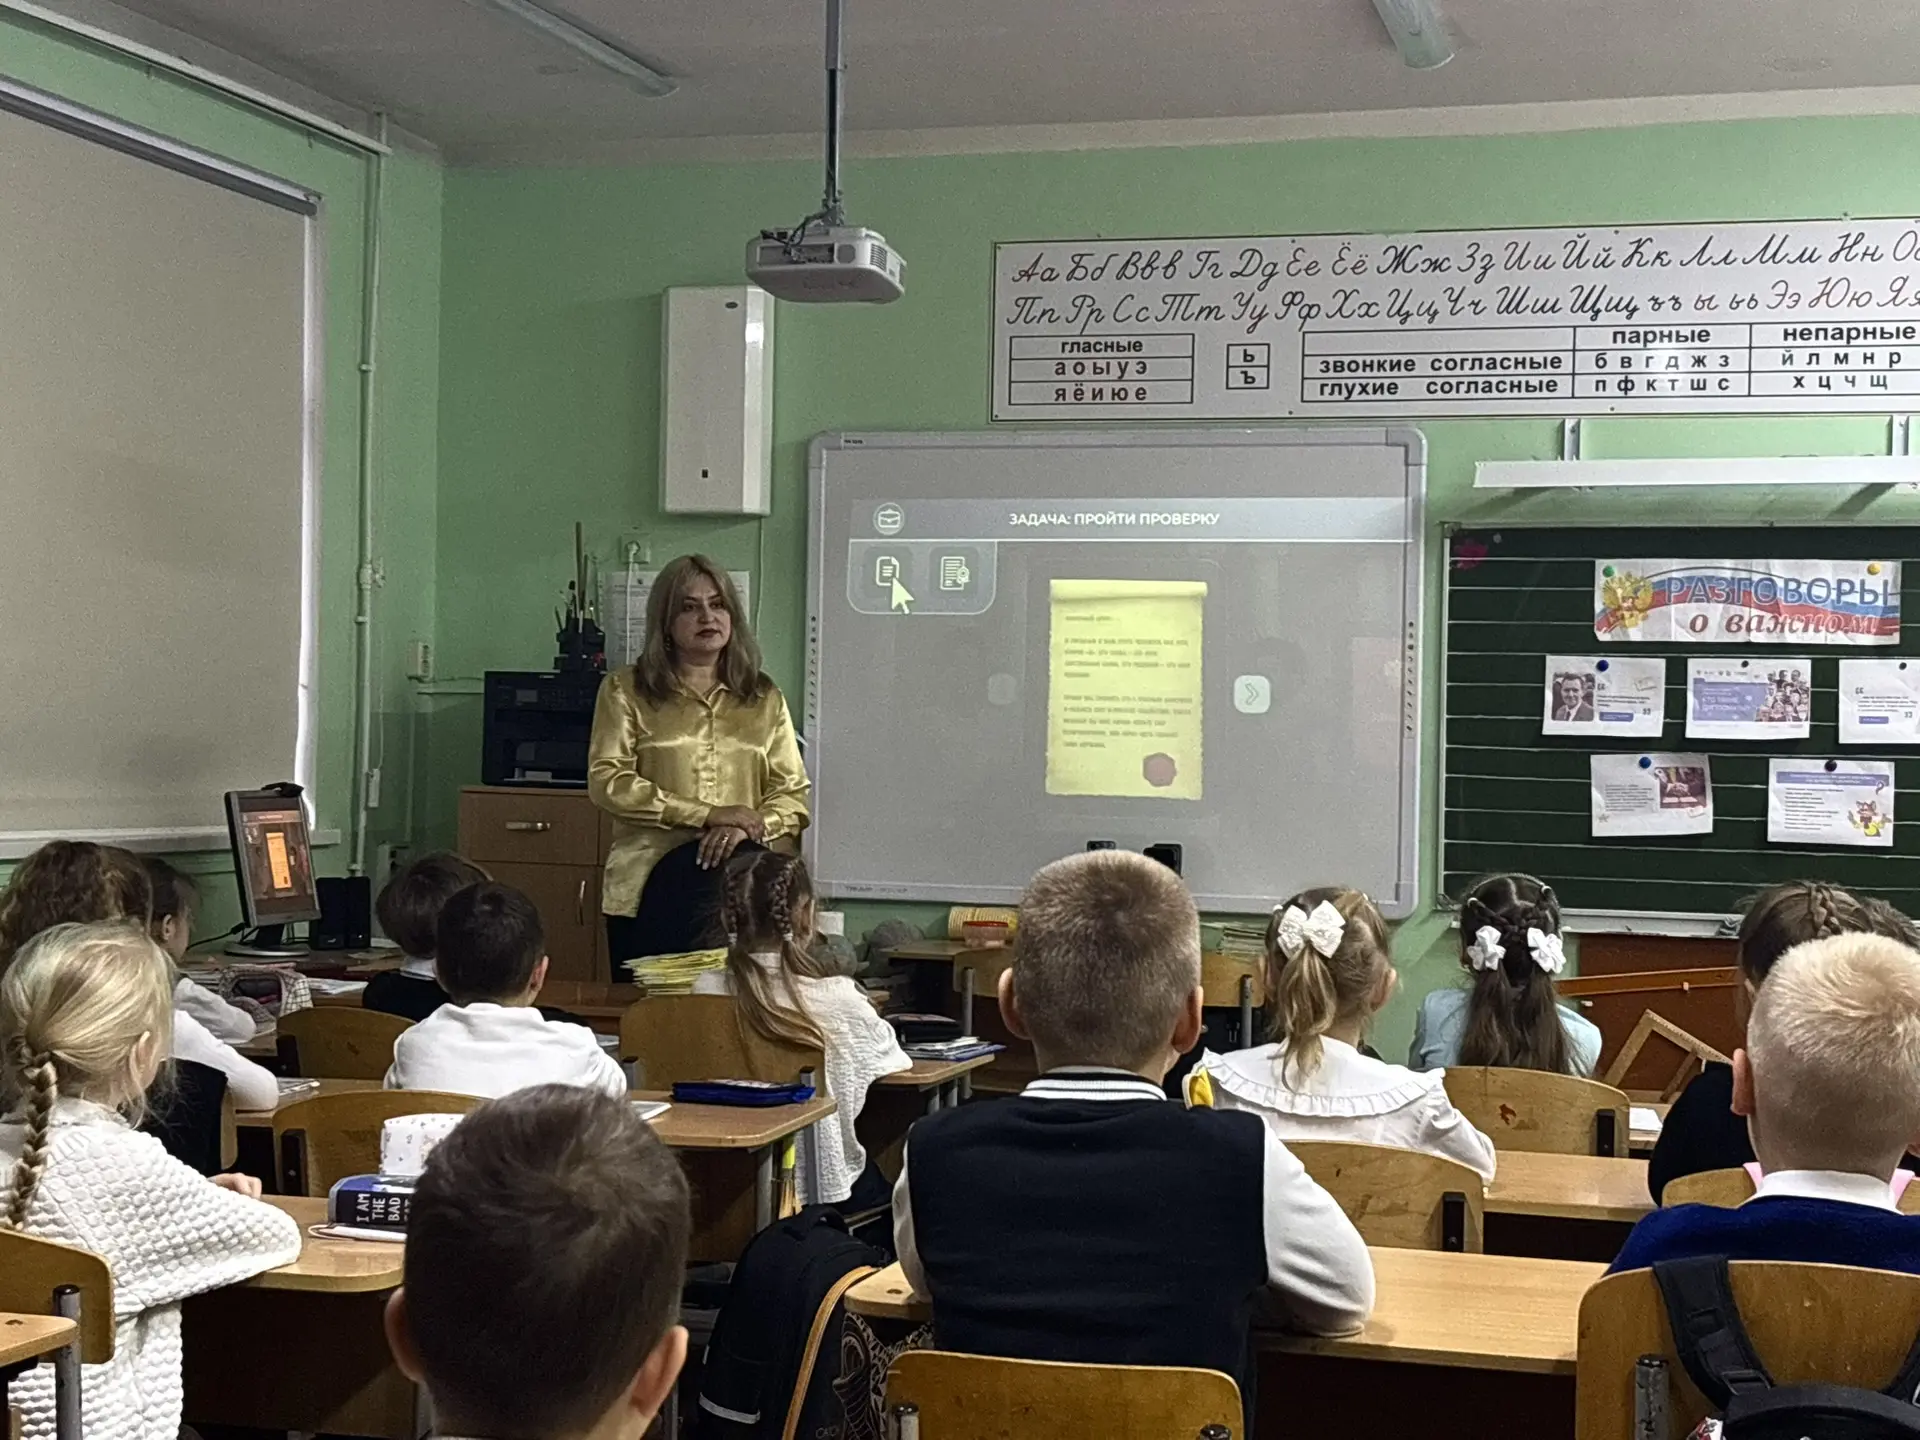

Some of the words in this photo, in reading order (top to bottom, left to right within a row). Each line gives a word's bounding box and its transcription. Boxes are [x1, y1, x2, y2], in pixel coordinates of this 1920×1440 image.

[1611, 327, 1712, 347] парные
[1782, 323, 1916, 344] непарные
[1061, 341, 1144, 354] гласные
[1243, 349, 1255, 362] ь
[1320, 359, 1415, 373] звонкие
[1430, 354, 1563, 372] согласные
[1595, 352, 1607, 369] б
[1621, 356, 1632, 368] в
[1645, 356, 1654, 368] г
[1665, 356, 1680, 371] д
[1692, 355, 1707, 367] ж
[1719, 355, 1729, 367] з
[1782, 348, 1793, 365] й
[1807, 353, 1819, 365] л
[1834, 353, 1848, 365] м
[1863, 352, 1874, 364] н
[1888, 352, 1902, 368] р
[1054, 361, 1067, 375] а
[1073, 361, 1086, 375] о
[1092, 361, 1110, 375] ы
[1116, 361, 1130, 379] у
[1136, 361, 1147, 374] э
[1240, 371, 1256, 384] ъ
[1055, 388, 1066, 401] я
[1073, 382, 1086, 401] ё
[1092, 388, 1103, 401] и
[1111, 388, 1128, 401] ю
[1135, 387, 1146, 400] е
[1319, 380, 1400, 400] глухие
[1425, 378, 1558, 394] согласные
[1595, 380, 1606, 392] п
[1617, 376, 1636, 396] ф
[1647, 379, 1657, 391] к
[1668, 379, 1679, 391] т
[1691, 379, 1706, 391] ш
[1718, 378, 1729, 390] с
[1793, 376, 1804, 388] х
[1819, 376, 1831, 390] ц
[1845, 376, 1856, 387] ч
[1870, 375, 1887, 390] щ
[1009, 513, 1071, 526] ЗАДАЧА:
[1074, 511, 1136, 525] ПРОЙТИ
[1139, 513, 1220, 525] ПРОВЕРКУ
[1665, 576, 1889, 606] РАЗГОВОРЫ
[1689, 613, 1708, 633] о
[1725, 611, 1880, 634] важном
[357, 1193, 371, 1212] AM
[372, 1198, 385, 1220] THE
[388, 1197, 401, 1221] BAD
